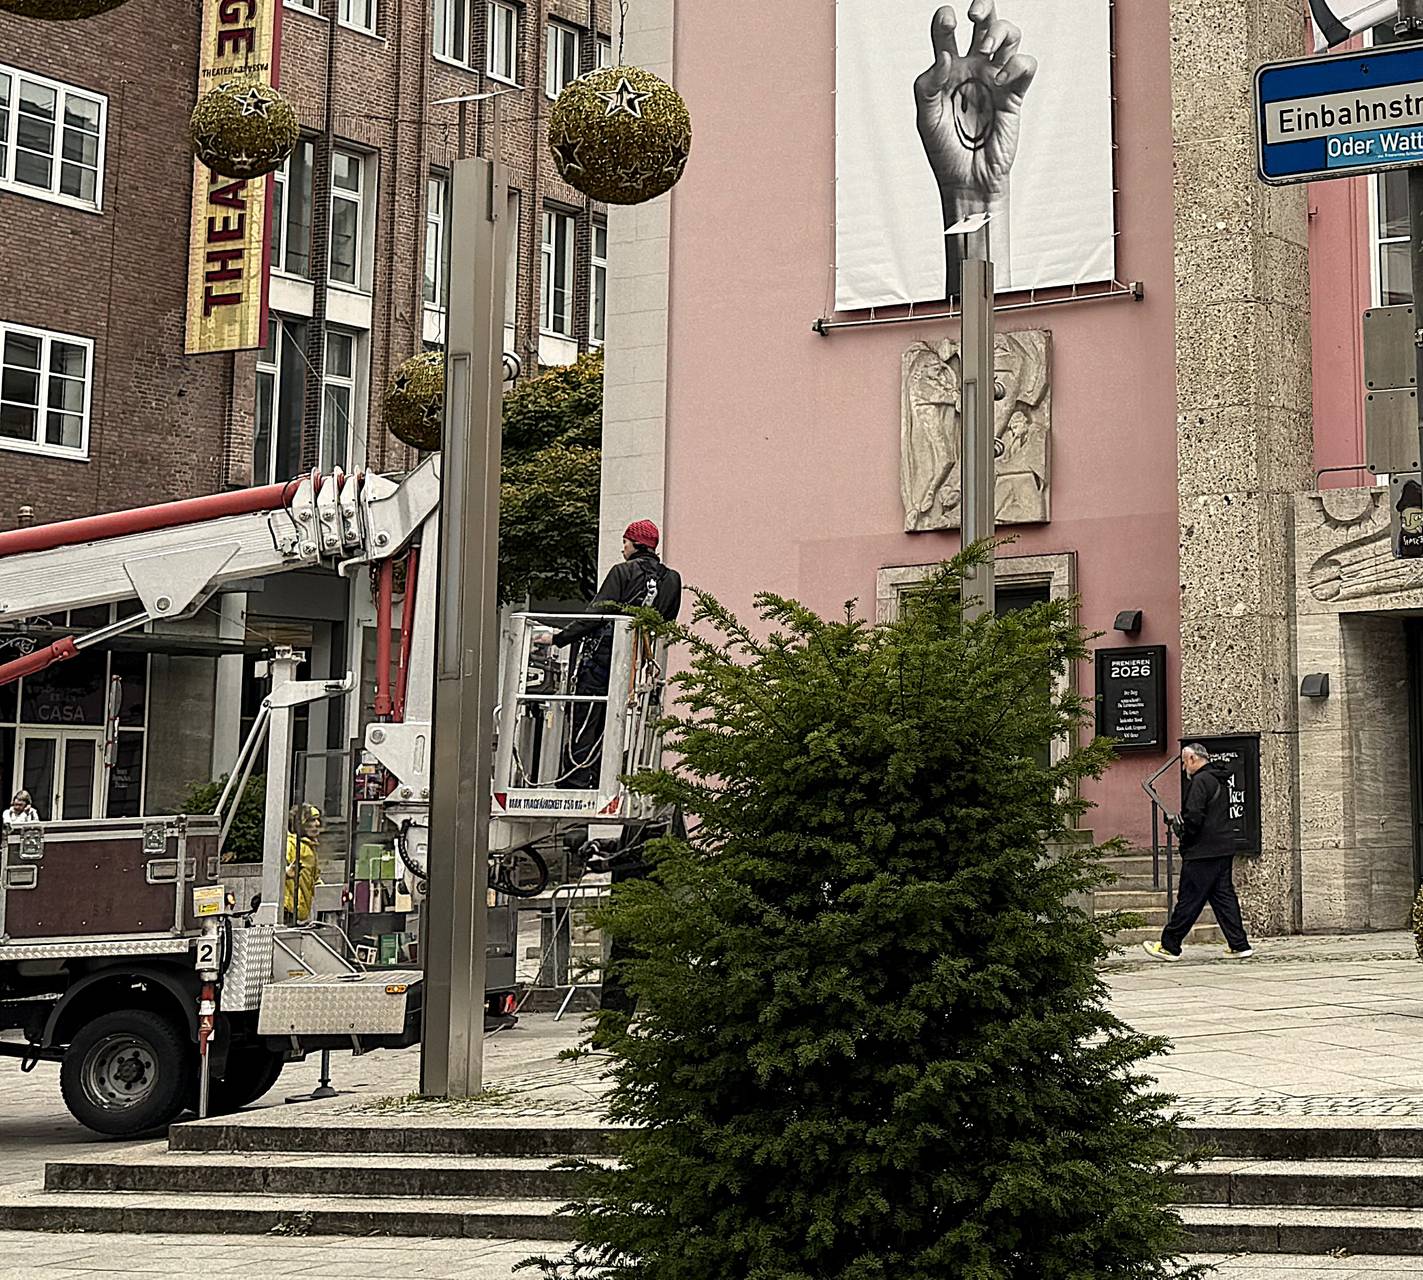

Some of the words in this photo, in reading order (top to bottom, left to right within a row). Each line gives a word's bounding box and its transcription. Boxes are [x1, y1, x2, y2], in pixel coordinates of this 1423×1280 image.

[1327, 137, 1375, 157] Oder
[1380, 131, 1423, 152] Watt
[1111, 665, 1151, 678] 2026
[38, 704, 85, 721] CASA
[199, 944, 213, 963] 2
